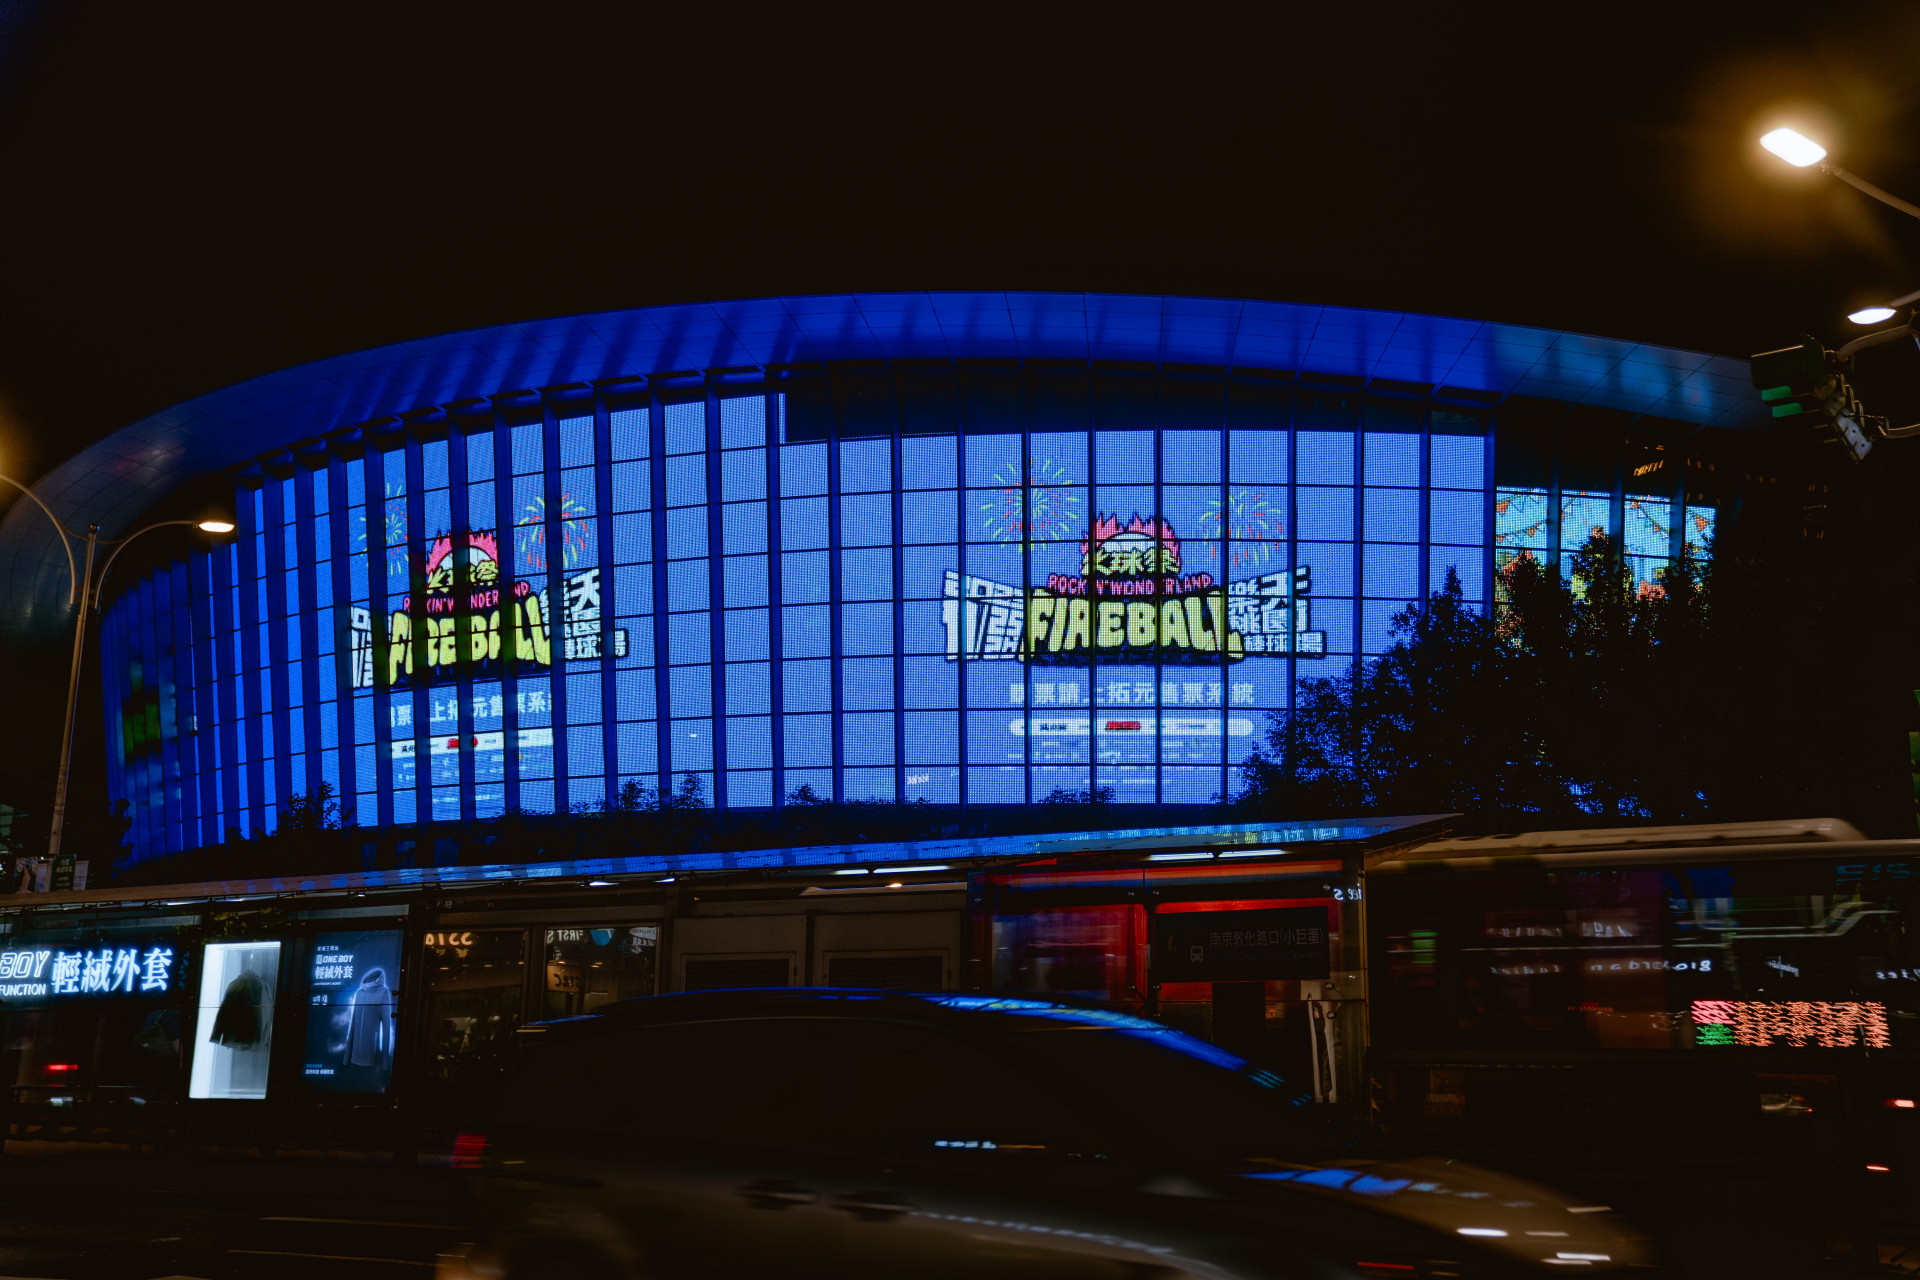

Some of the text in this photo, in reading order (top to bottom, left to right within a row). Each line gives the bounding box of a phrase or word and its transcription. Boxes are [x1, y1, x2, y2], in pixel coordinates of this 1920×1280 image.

[1020, 588, 1244, 660] FIREBALL
[51, 947, 173, 995] 輕絨外套
[322, 955, 338, 964] ONE
[338, 954, 354, 964] BOY
